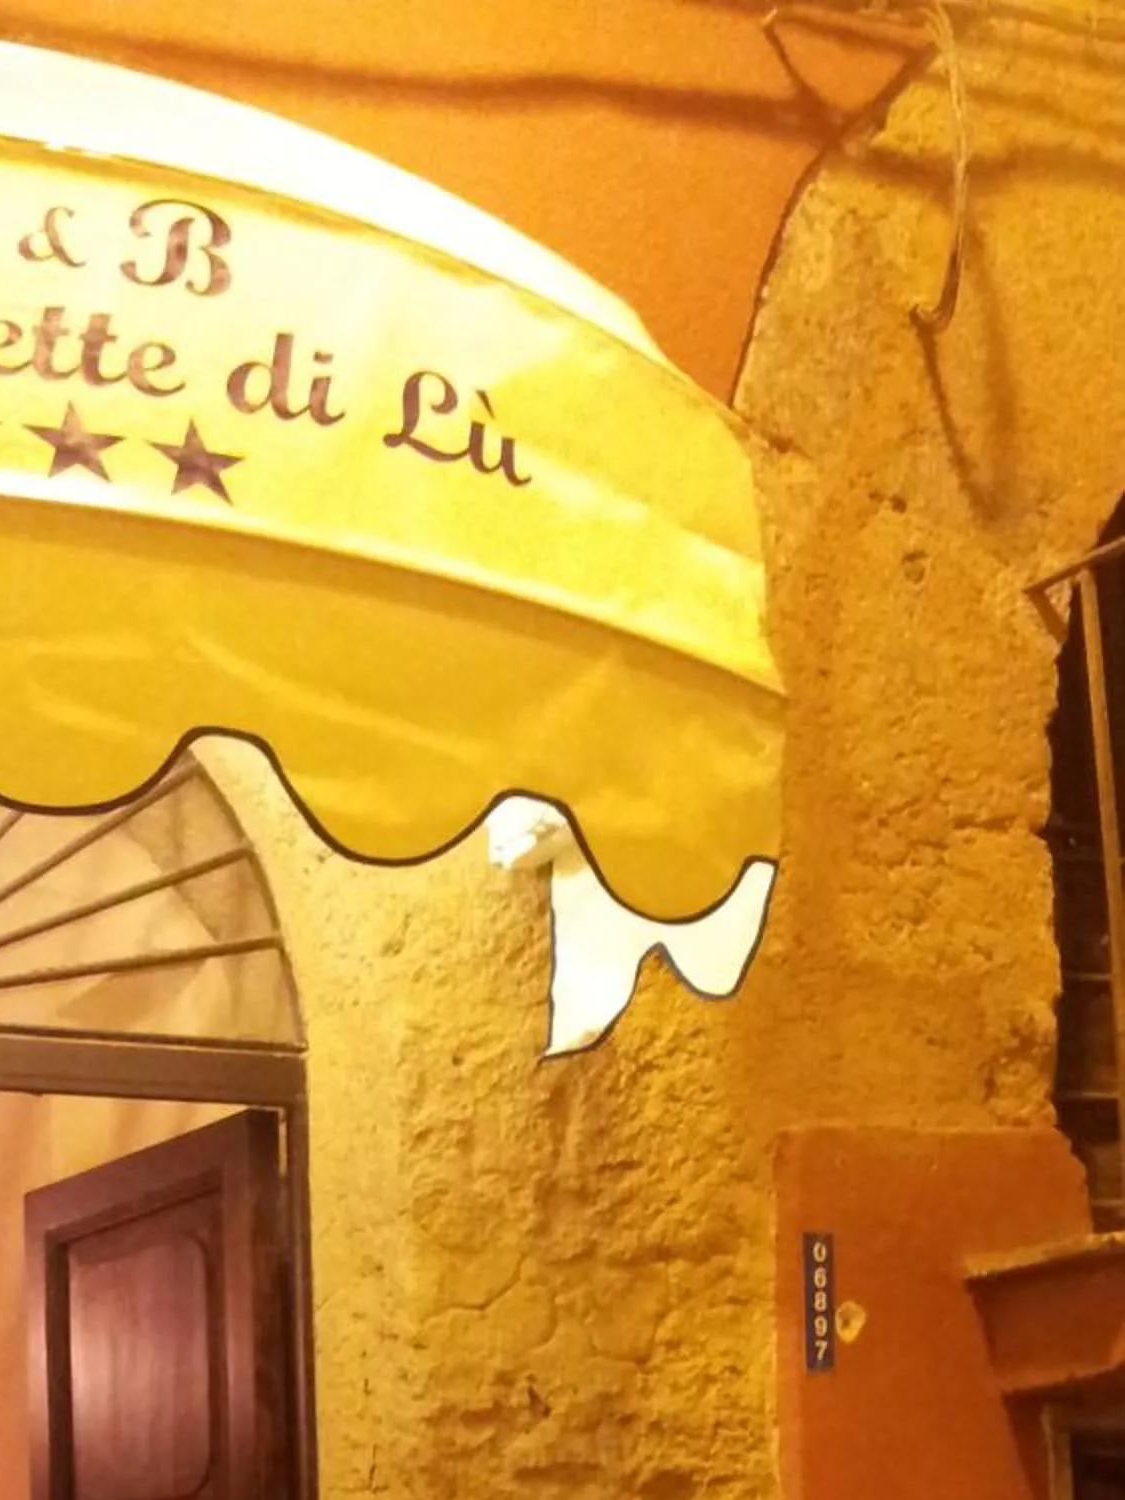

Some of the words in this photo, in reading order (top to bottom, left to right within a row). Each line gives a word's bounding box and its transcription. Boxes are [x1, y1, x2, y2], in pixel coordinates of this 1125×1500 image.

[17, 204, 80, 267] &
[119, 198, 232, 297] B
[225, 332, 346, 428] di
[382, 370, 533, 488] Lù
